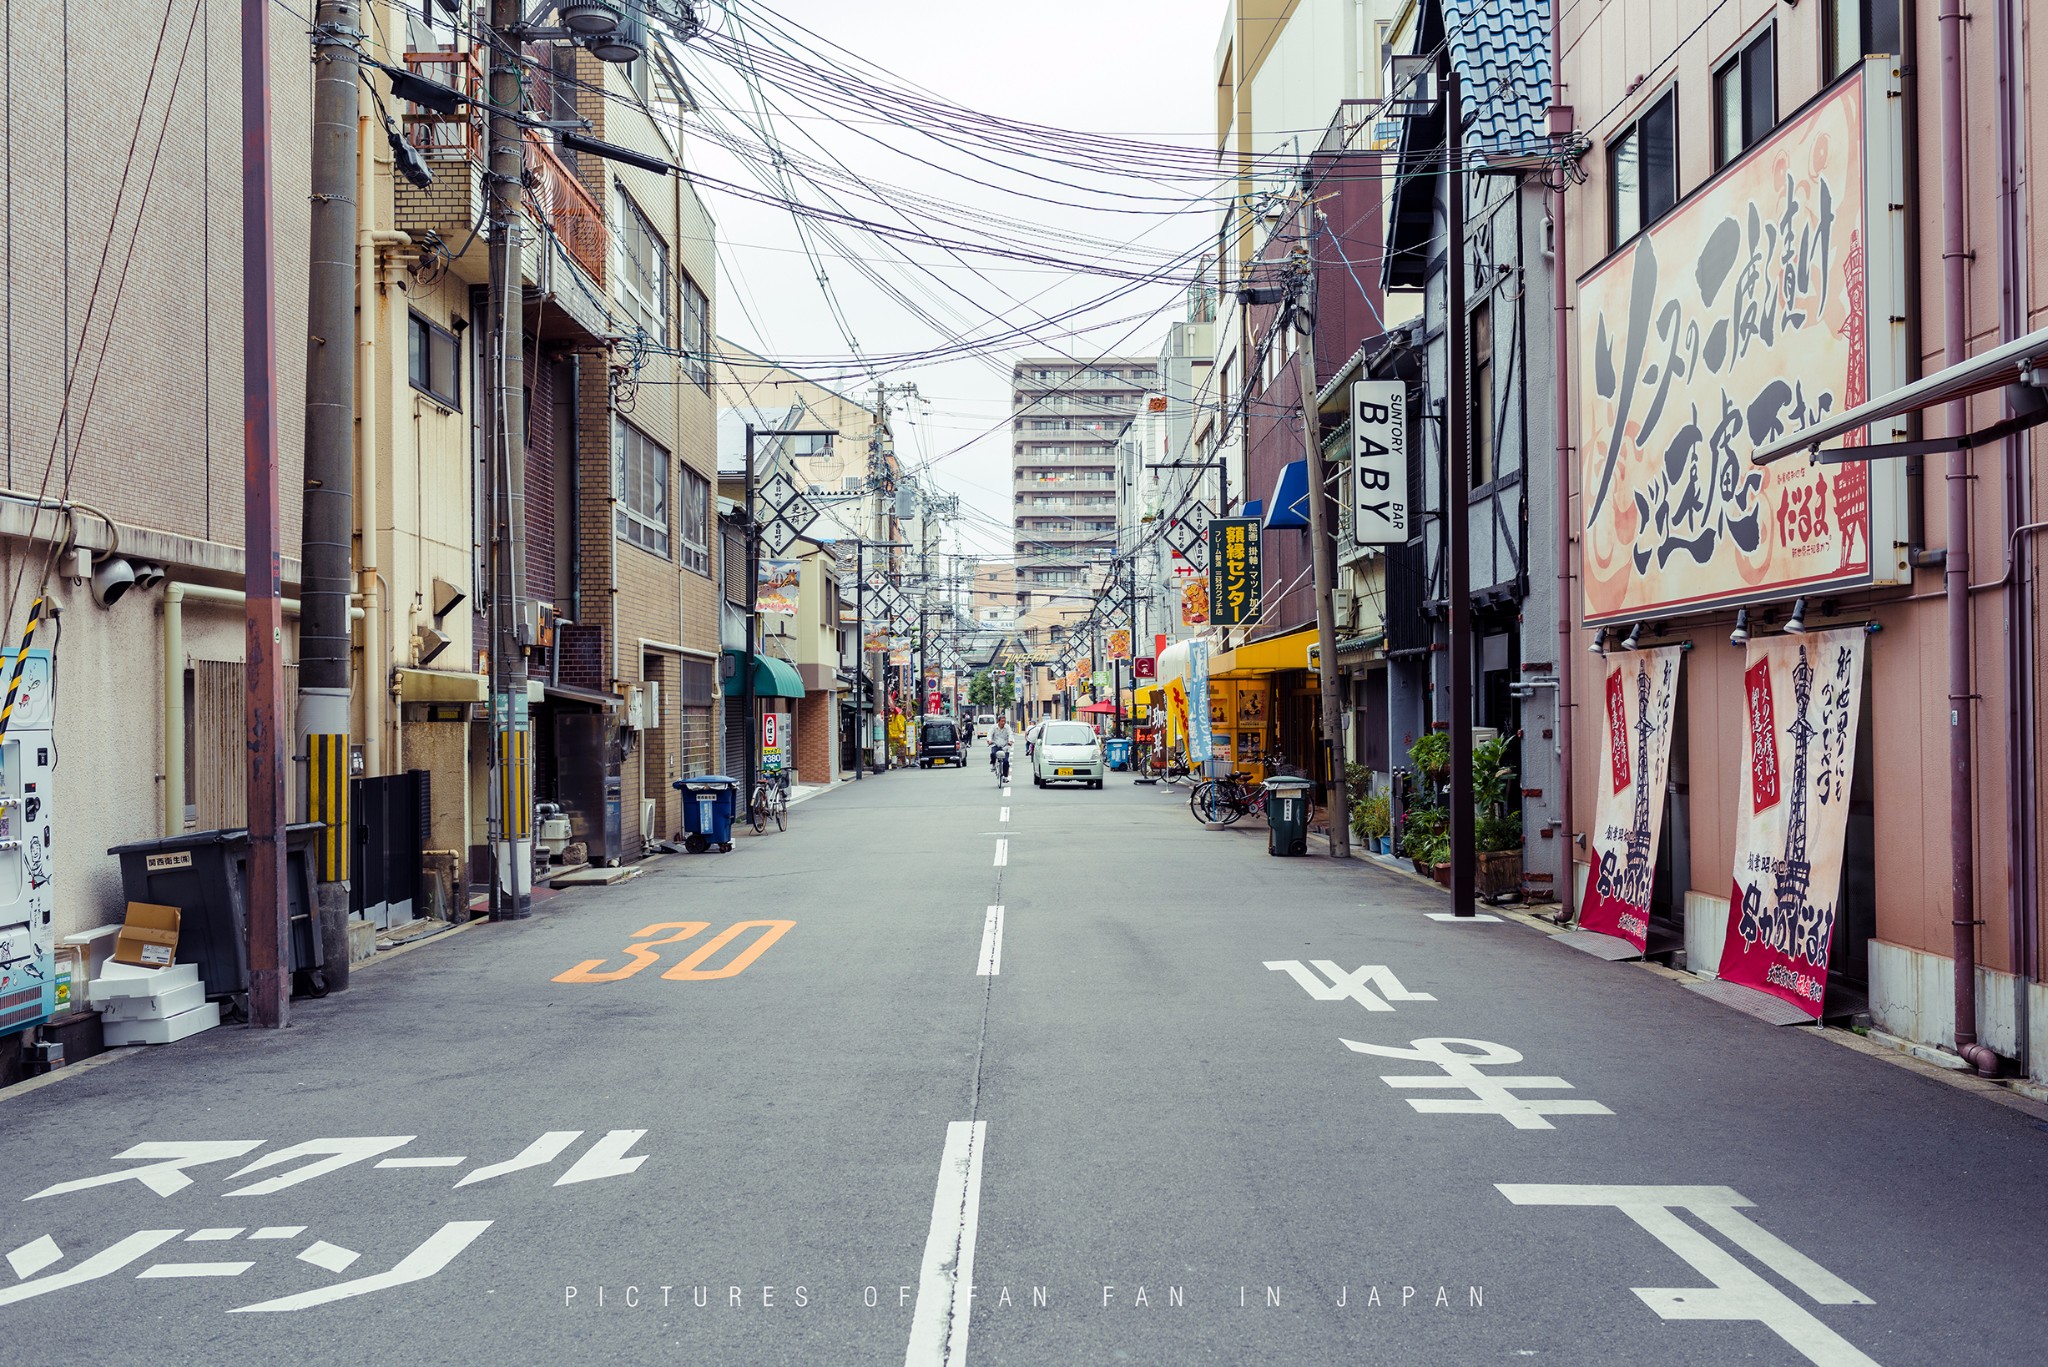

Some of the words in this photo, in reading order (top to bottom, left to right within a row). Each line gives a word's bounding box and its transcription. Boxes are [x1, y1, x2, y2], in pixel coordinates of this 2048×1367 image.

[1360, 401, 1391, 523] BABY
[1391, 394, 1402, 455] SUNTORY
[1393, 503, 1403, 530] BAR
[1776, 471, 1829, 548] だるま
[1225, 526, 1246, 623] 額縁センター
[1817, 680, 1834, 806] おいでやす
[1836, 645, 1852, 802] 新世界にも
[552, 920, 797, 983] 30
[1739, 880, 1835, 969] 串かつだるま
[22, 1129, 648, 1202] スクール
[0, 1220, 495, 1314] ゾーン
